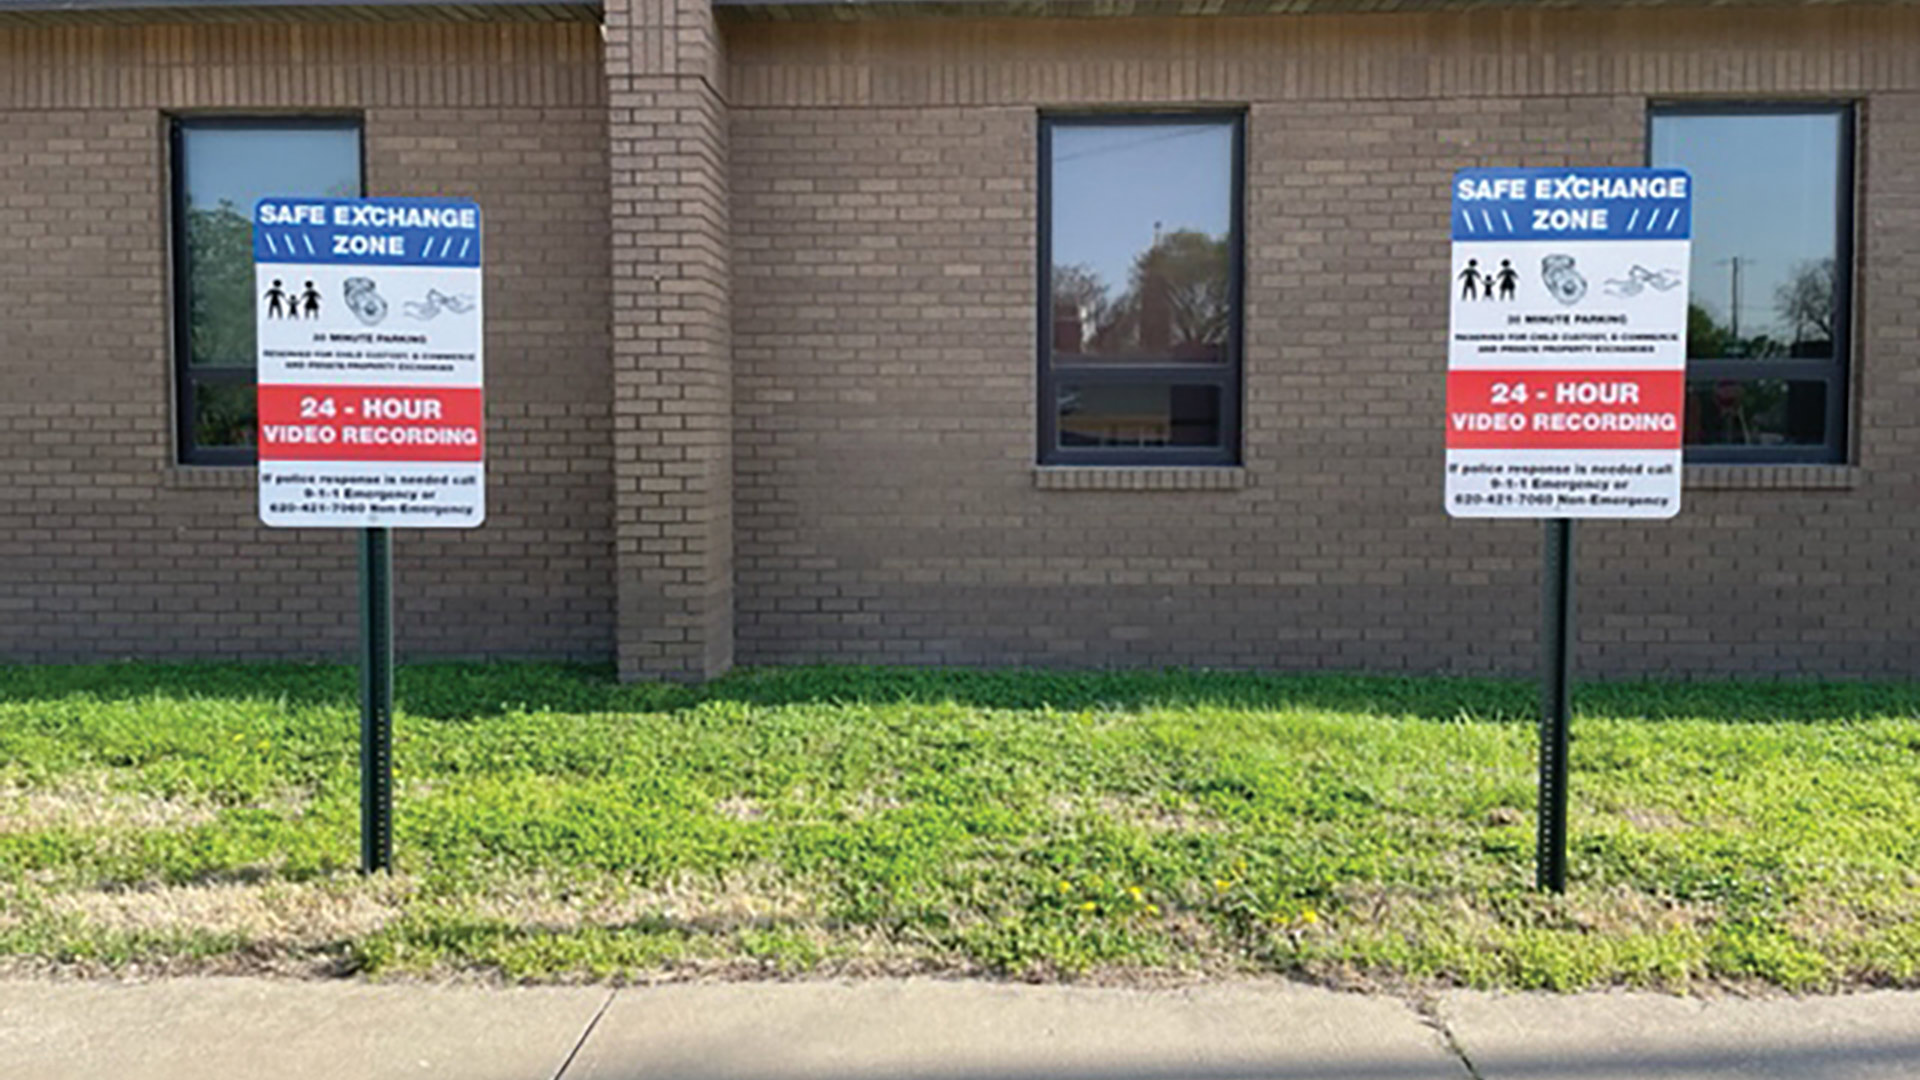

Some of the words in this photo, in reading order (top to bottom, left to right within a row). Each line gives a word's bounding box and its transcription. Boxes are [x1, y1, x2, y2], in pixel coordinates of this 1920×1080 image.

[1458, 179, 1527, 200] SAFE
[1535, 177, 1687, 199] EXCHANGE
[259, 204, 326, 226] SAFE
[333, 205, 476, 229] EXCHANGE
[1532, 209, 1608, 230] ZONE
[332, 235, 405, 255] ZONE
[1525, 315, 1570, 325] MINUTE
[1574, 314, 1627, 325] PARKING
[329, 333, 373, 343] MINUTE
[377, 333, 427, 344] PARKING
[1490, 382, 1528, 404] 24
[1555, 382, 1639, 404] HOUR
[300, 396, 337, 418] 24
[362, 398, 442, 419] HOUR
[1451, 413, 1527, 431] VIDEO
[1532, 413, 1677, 431] RECORDING
[263, 425, 337, 443] VIDEO
[342, 426, 478, 446] RECORDING
[1449, 463, 1459, 473] If
[1462, 463, 1503, 476] police
[1508, 465, 1570, 476] response
[1575, 464, 1586, 474] is
[1591, 464, 1643, 475] needed
[1647, 464, 1673, 474] call
[262, 473, 272, 482] If
[276, 473, 315, 485] police
[319, 475, 380, 486] response
[384, 473, 396, 484] is
[400, 474, 448, 485] needed
[452, 475, 476, 485] call
[1490, 478, 1527, 489] 9-1-1
[1532, 478, 1609, 491] Emergency
[1613, 481, 1629, 489] or
[304, 488, 339, 498] 9-1-1
[344, 488, 417, 501] Emergency
[422, 491, 435, 499] or
